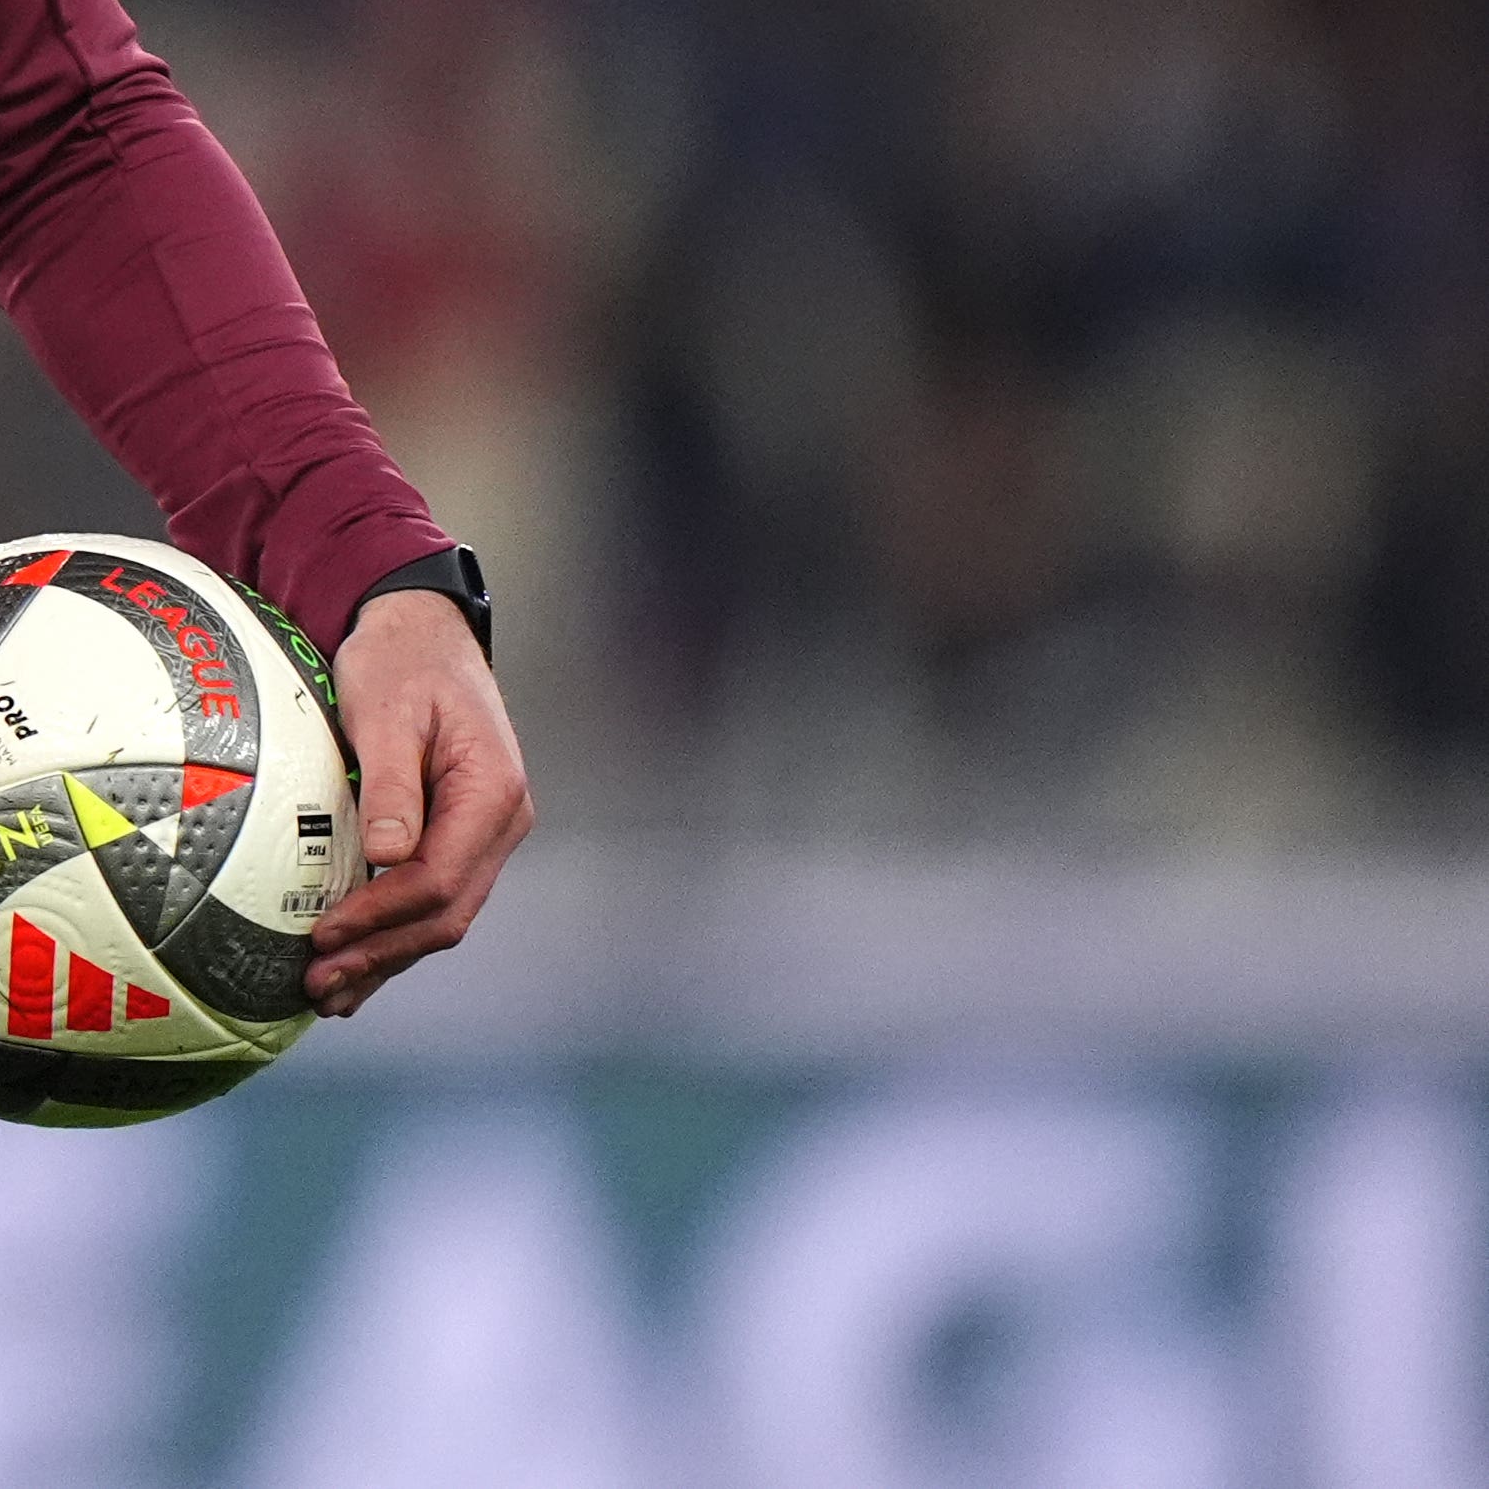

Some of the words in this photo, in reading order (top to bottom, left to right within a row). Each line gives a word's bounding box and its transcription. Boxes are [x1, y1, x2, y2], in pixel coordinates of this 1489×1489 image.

[99, 566, 241, 719] LEAGUE
[29, 803, 54, 847] UEFA
[306, 844, 326, 856] FIFA
